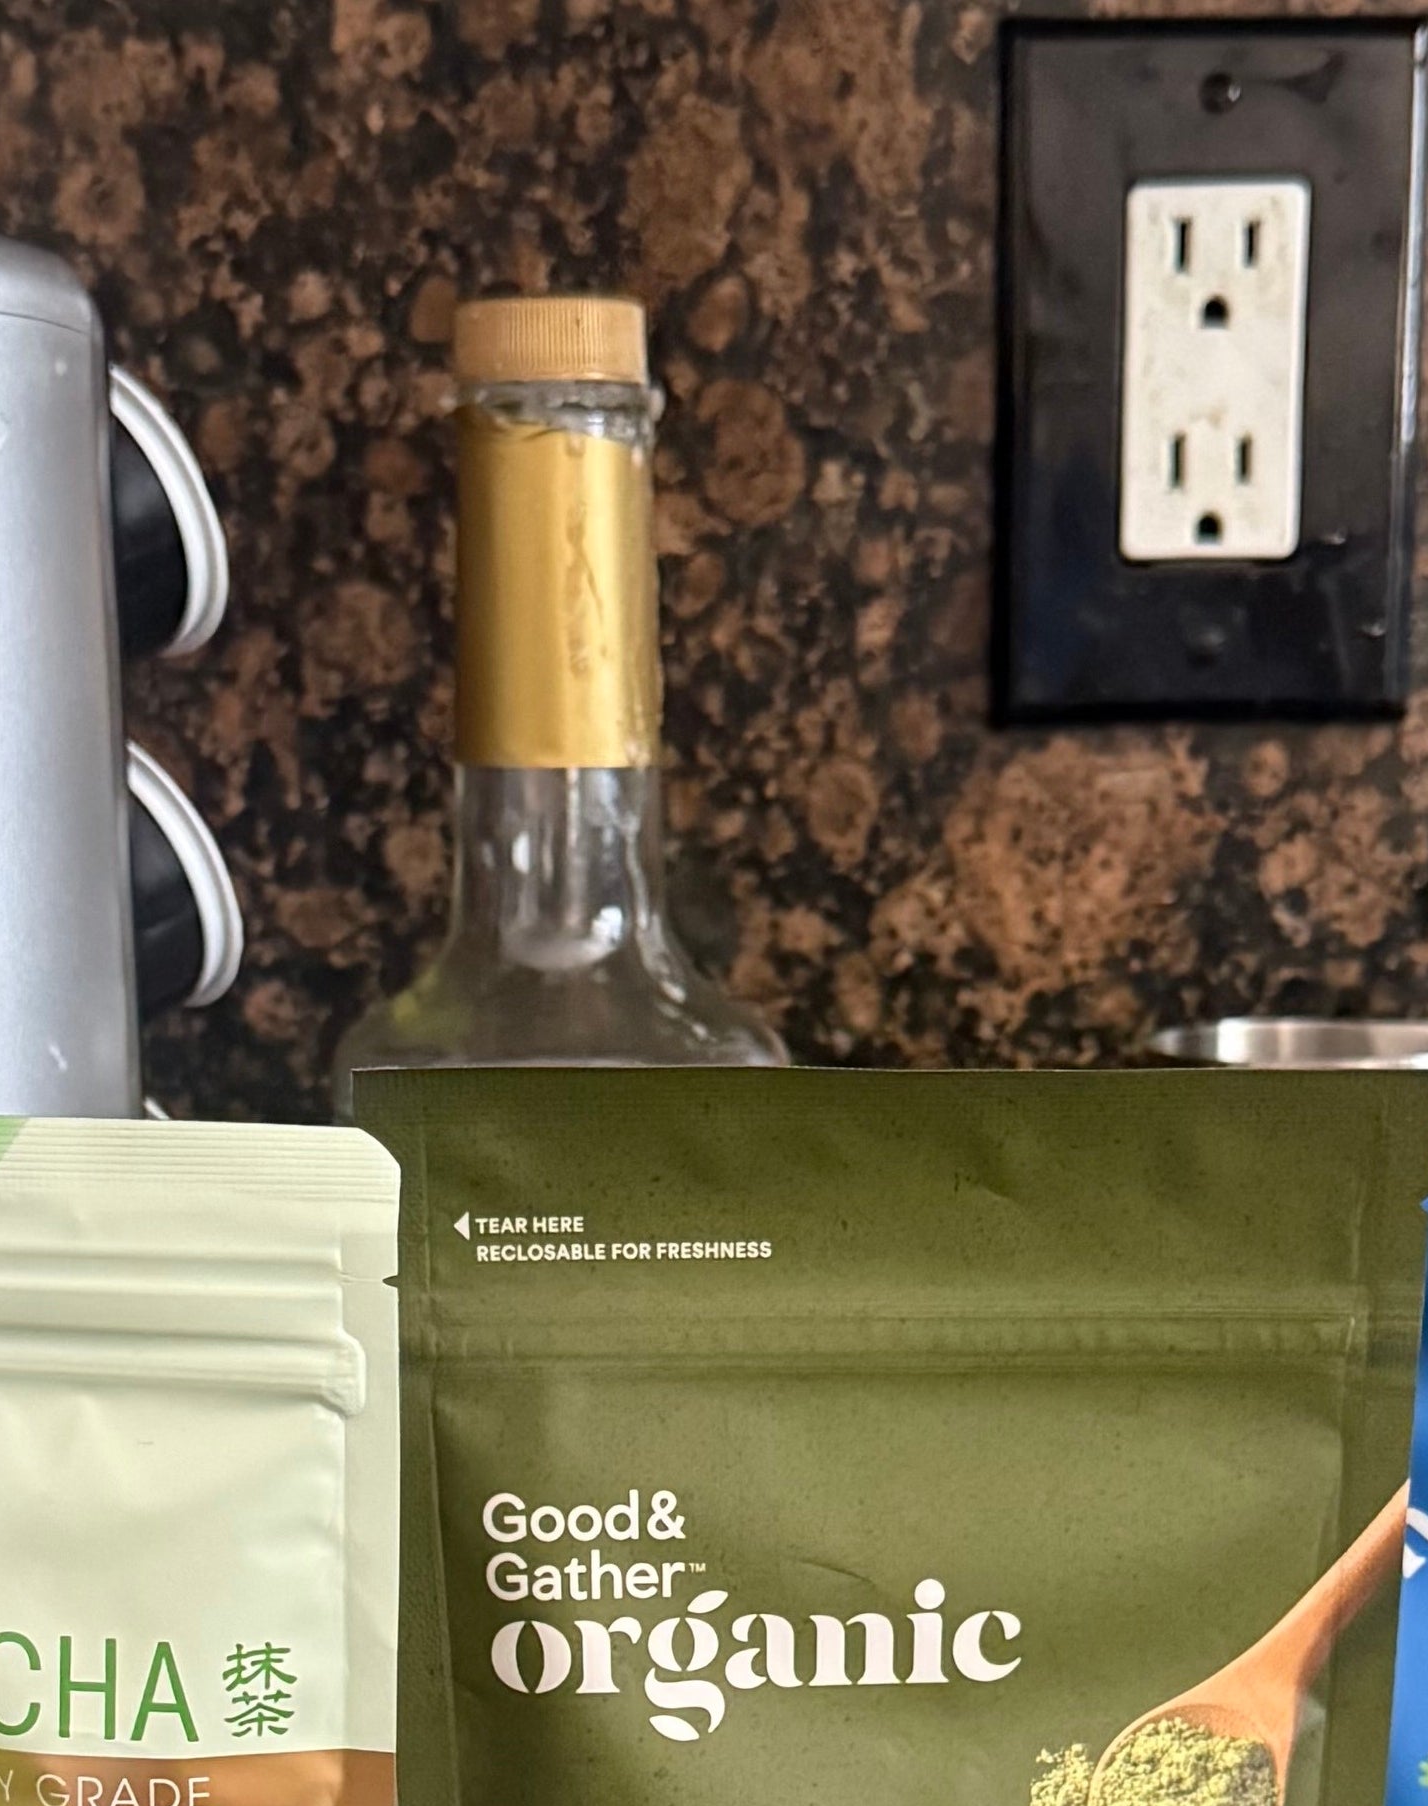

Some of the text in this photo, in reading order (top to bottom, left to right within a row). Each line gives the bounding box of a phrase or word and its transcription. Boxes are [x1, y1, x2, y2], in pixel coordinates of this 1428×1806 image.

[475, 1216, 584, 1234] TEAR HERE
[477, 1241, 771, 1262] RECLOSABLE FOR FRESHNESS
[490, 1578, 1022, 1741] organic
[222, 1642, 297, 1738] 抹茶
